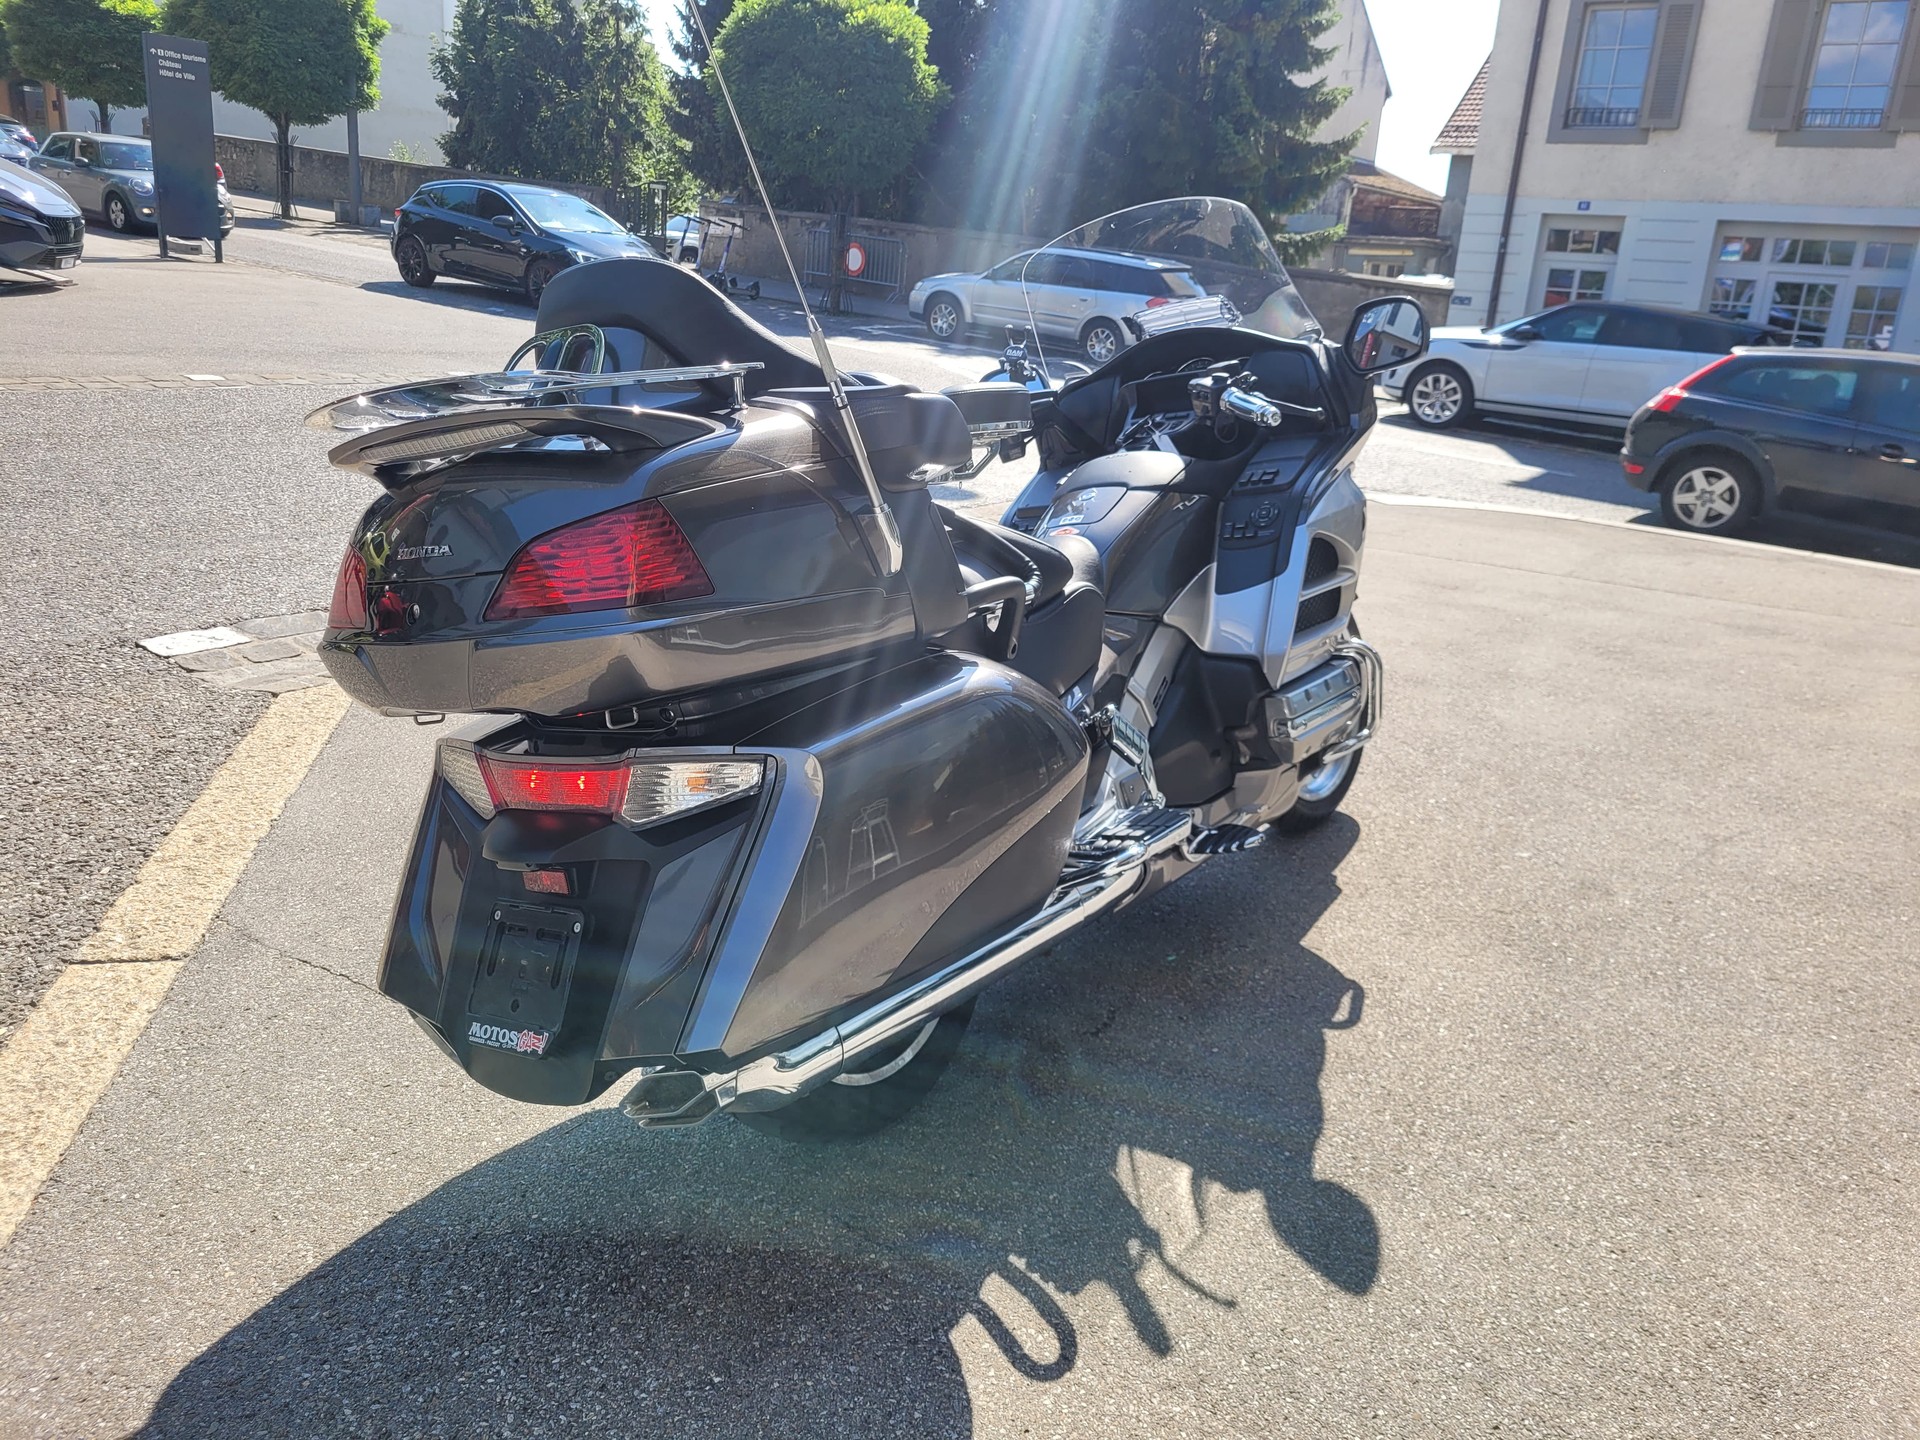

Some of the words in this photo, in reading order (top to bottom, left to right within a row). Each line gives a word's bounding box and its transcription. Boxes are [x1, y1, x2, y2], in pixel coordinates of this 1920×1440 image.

[164, 50, 181, 59] Office
[182, 53, 207, 63] tourisme
[159, 69, 174, 78] Hôtel
[183, 73, 196, 81] Ville
[397, 545, 453, 560] HONDA
[468, 1022, 518, 1045] MOTOS
